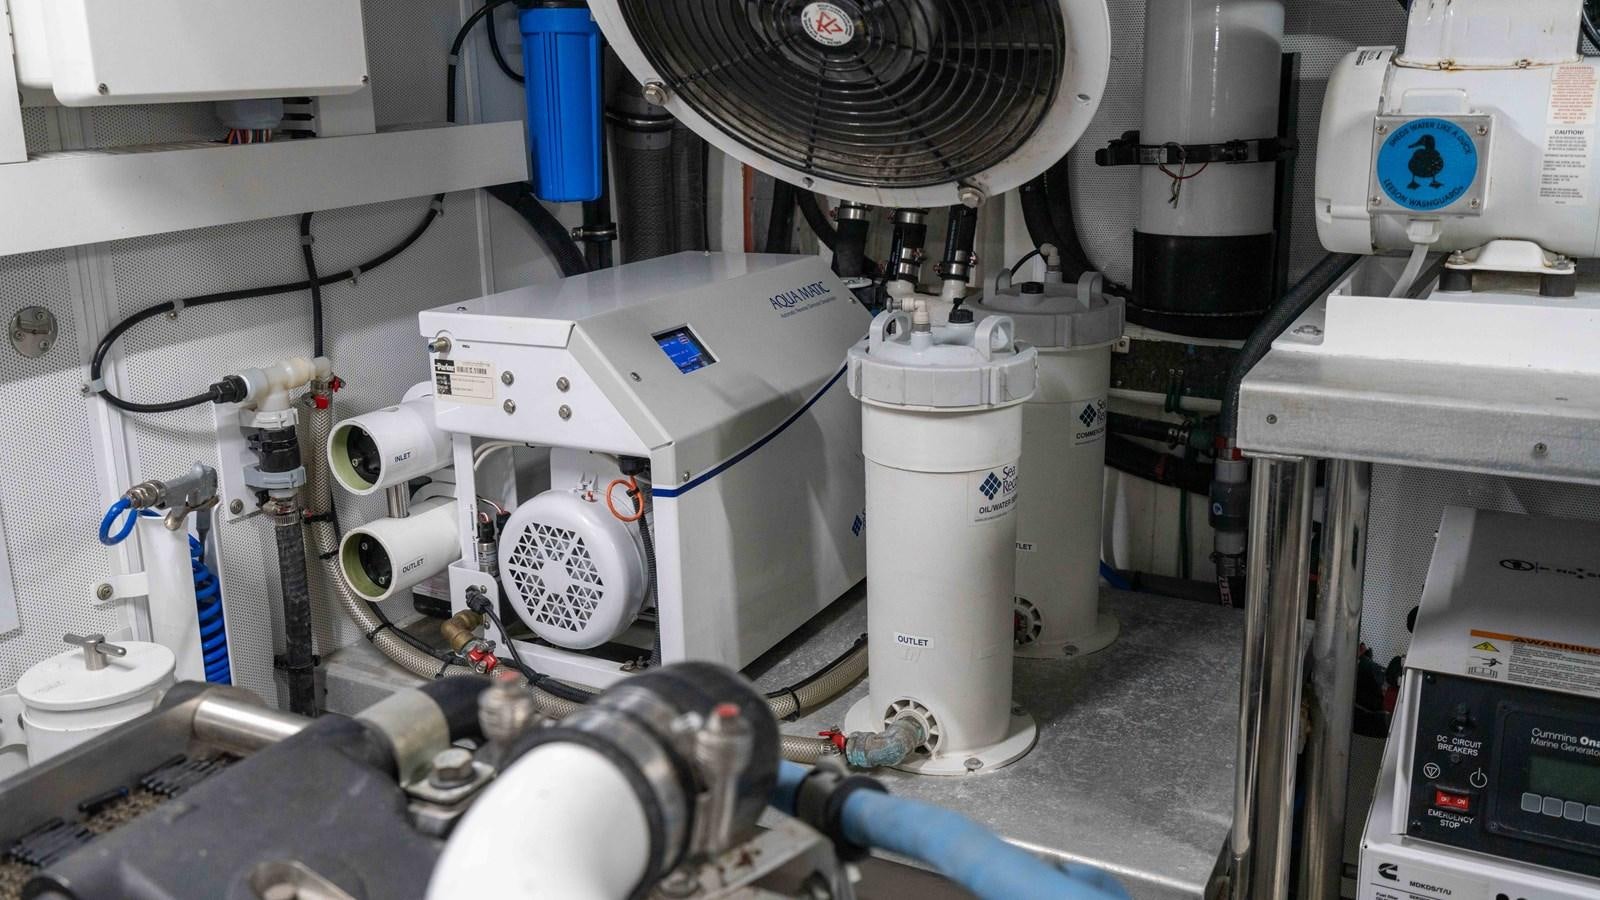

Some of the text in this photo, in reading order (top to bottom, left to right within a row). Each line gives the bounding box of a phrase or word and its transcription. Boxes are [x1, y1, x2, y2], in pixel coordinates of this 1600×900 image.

[1409, 121, 1436, 130] WATER
[1457, 134, 1472, 155] DUCK
[1383, 178, 1409, 202] LEESON
[769, 290, 803, 310] AQUA
[797, 281, 831, 301] MATIC
[394, 451, 411, 463] INLET
[1003, 465, 1016, 481] Sea
[402, 558, 425, 574] OUTLET
[897, 635, 929, 646] OUTLET
[1436, 734, 1482, 749] DC CIRCUIT
[1530, 737, 1559, 750] Marine
[1531, 727, 1578, 744] Cummins
[1437, 742, 1479, 757] BREAKERS
[1427, 808, 1474, 825] EMERGENCY
[1440, 819, 1460, 829] STOP
